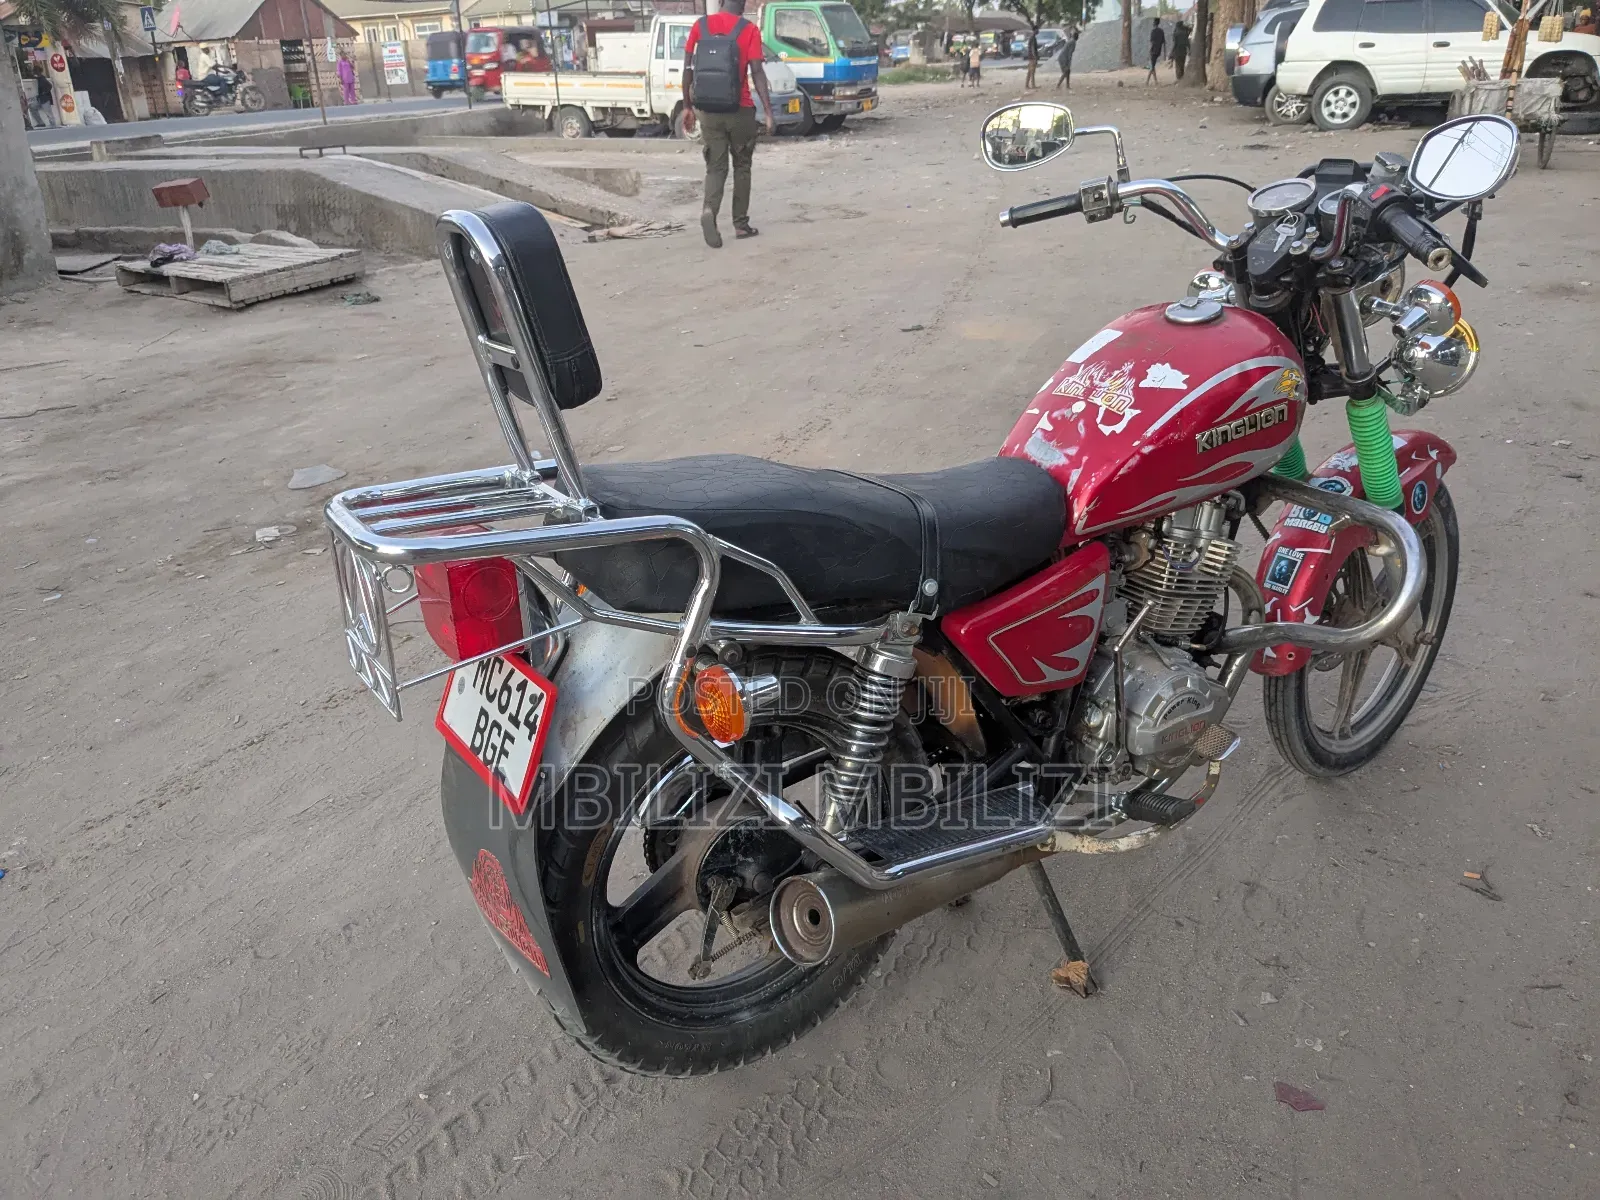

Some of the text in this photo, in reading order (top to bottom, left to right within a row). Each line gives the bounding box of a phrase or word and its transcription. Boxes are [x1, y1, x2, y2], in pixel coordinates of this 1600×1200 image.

[1195, 401, 1289, 454] KINGLION
[1277, 546, 1305, 560] ONE LOVE
[472, 656, 545, 742] MC614
[1163, 696, 1201, 721] Power King
